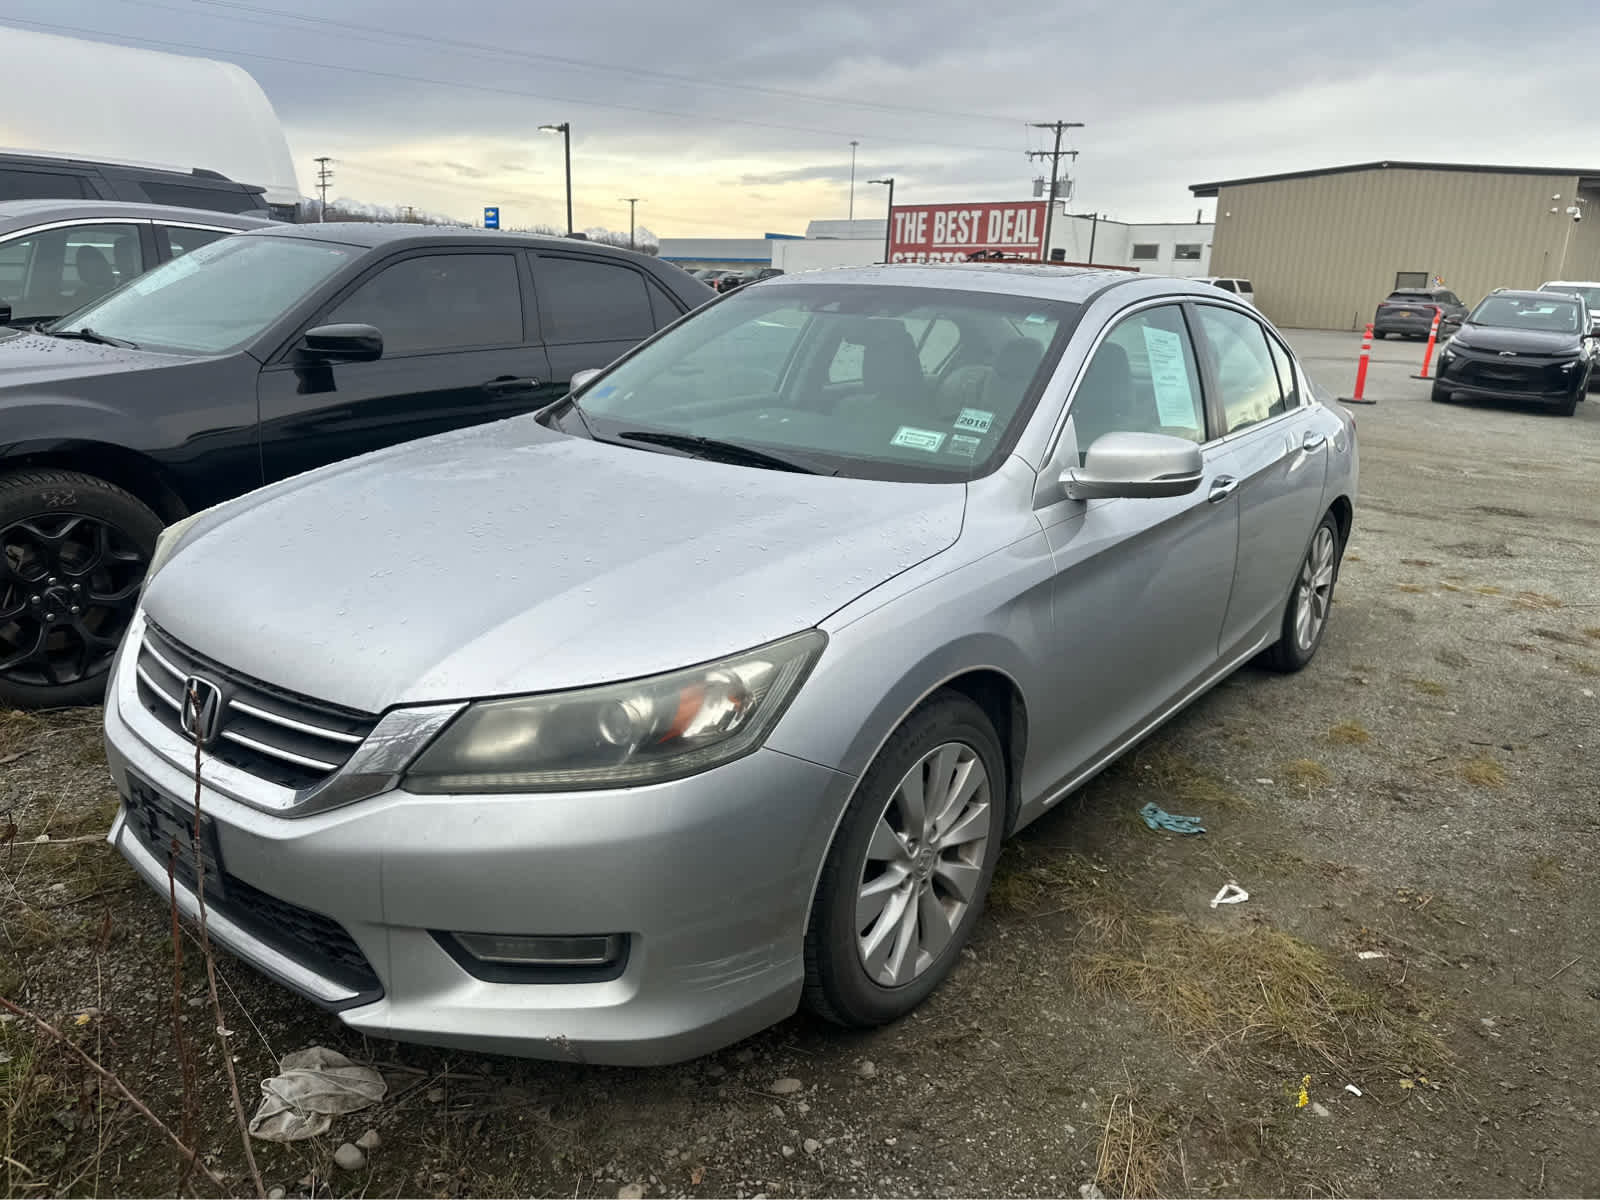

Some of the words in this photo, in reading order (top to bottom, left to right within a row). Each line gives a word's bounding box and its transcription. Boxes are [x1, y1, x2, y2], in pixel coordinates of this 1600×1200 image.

[895, 211, 928, 244] THE
[932, 209, 982, 244] BEST
[987, 208, 1039, 244] DEAL
